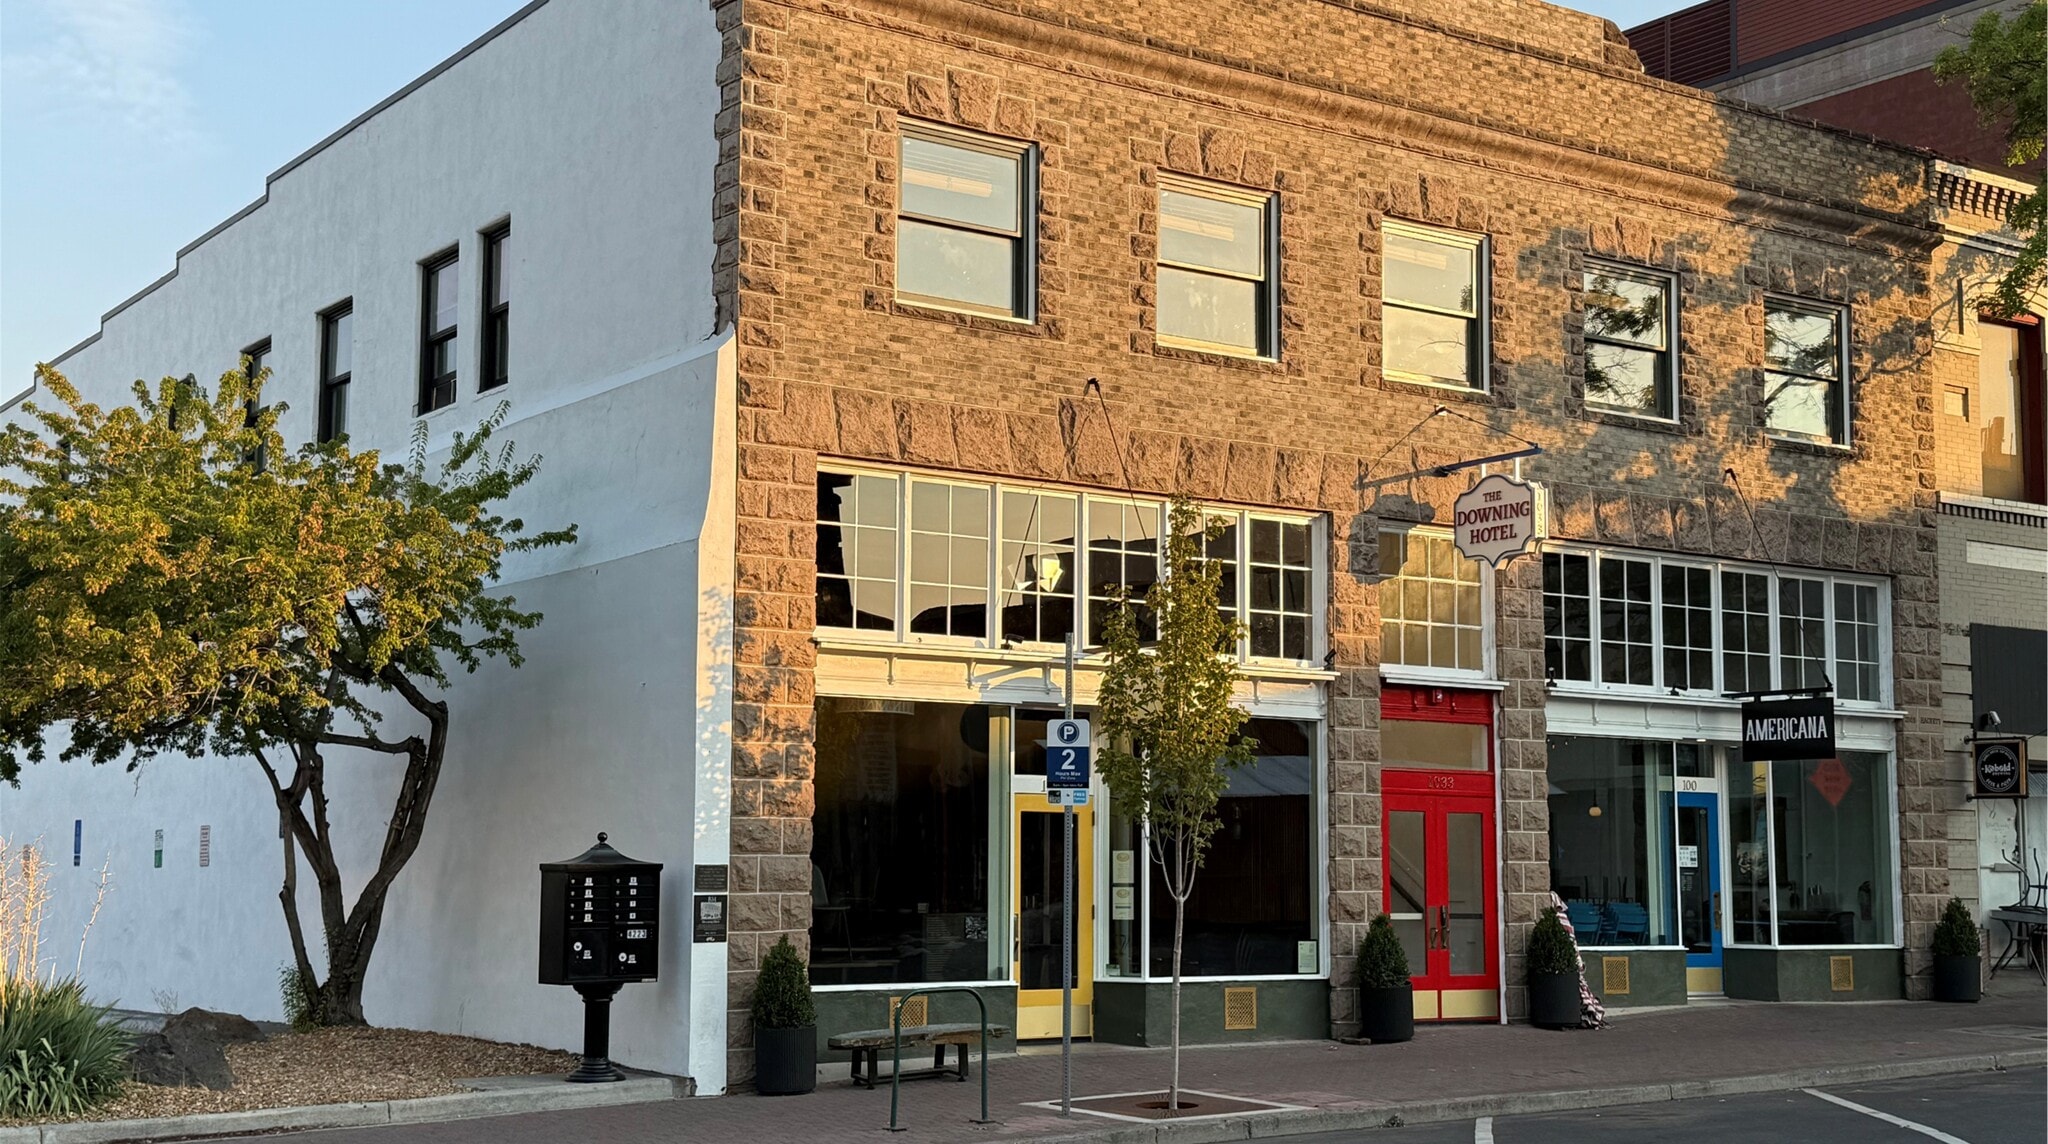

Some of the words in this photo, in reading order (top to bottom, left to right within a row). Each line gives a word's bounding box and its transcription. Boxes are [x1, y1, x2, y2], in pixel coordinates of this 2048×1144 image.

[1483, 490, 1502, 503] THE
[1457, 500, 1531, 527] DOWNING
[1469, 524, 1518, 545] HOTEL
[1063, 725, 1075, 740] P
[1745, 715, 1828, 742] AMERICANA
[1061, 748, 1076, 770] 2
[1984, 762, 2011, 774] Kobold
[1682, 779, 1697, 791] 100
[627, 930, 647, 939] 4223
